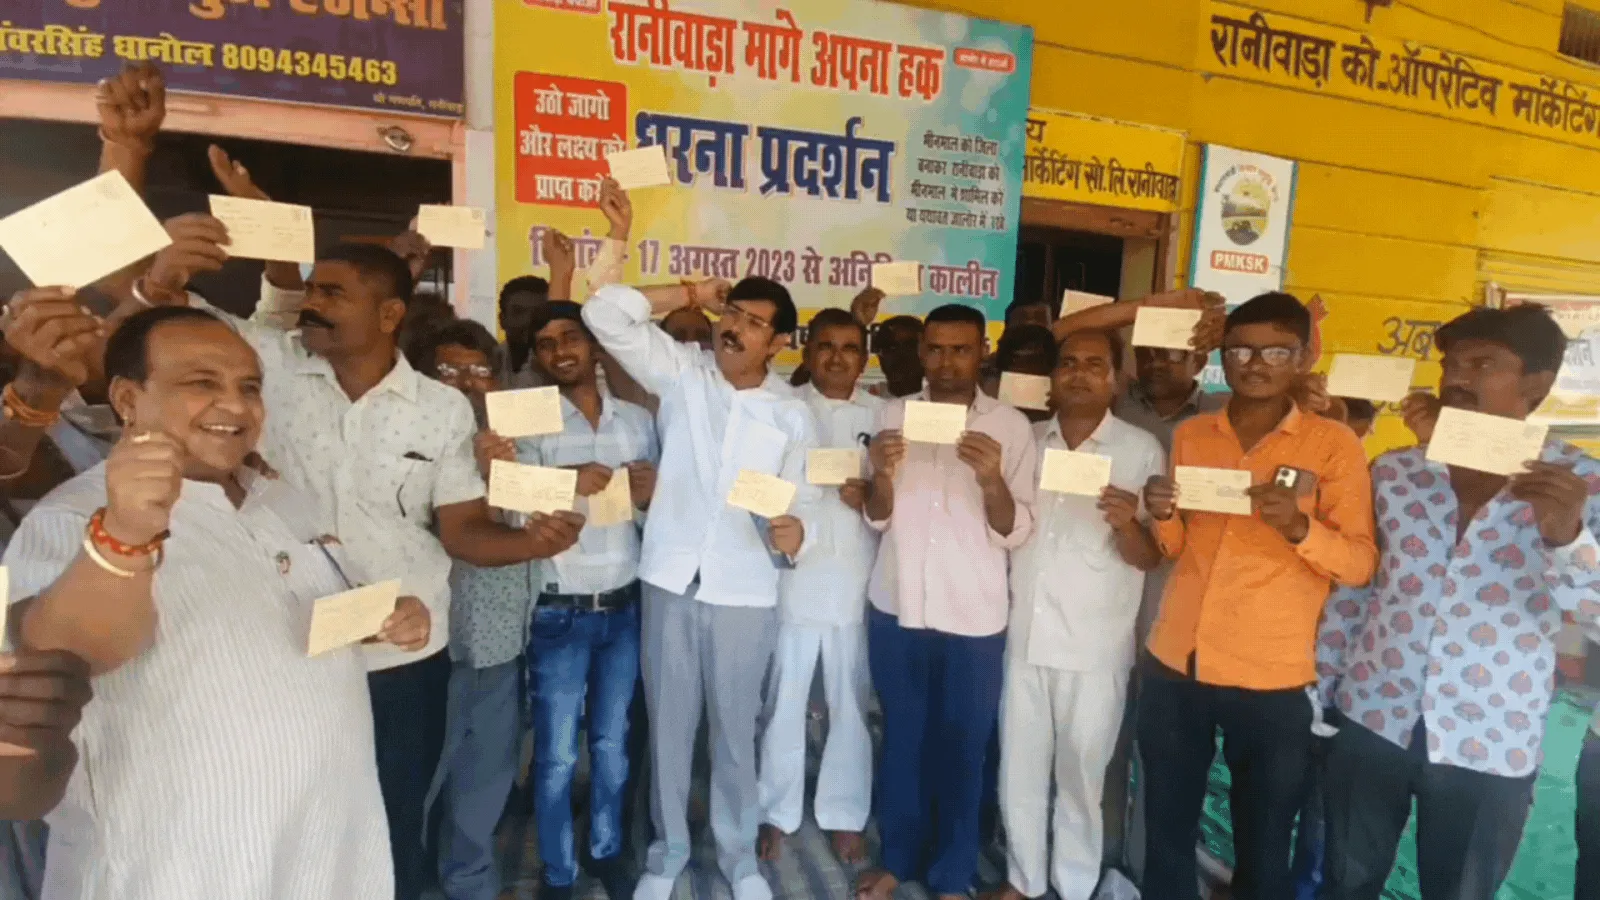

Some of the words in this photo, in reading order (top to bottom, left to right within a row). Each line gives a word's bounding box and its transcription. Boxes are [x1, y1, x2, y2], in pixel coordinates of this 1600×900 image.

[0, 20, 105, 57] ंवरसिंह
[222, 44, 397, 85] 8094345463
[811, 31, 892, 95] अपना
[897, 44, 945, 100] हक
[1211, 13, 1336, 88] रानीवाड़ा
[534, 84, 564, 116] उठो
[567, 89, 610, 120] जागो
[520, 124, 553, 156] और
[757, 116, 895, 202] प्रदर्शन
[535, 174, 574, 200] प्राप्त
[638, 240, 660, 274] 17
[669, 245, 740, 279] अगस्त
[745, 248, 795, 283] 2023
[802, 247, 823, 284] से
[928, 260, 999, 297] कालीन
[1215, 253, 1266, 271] PMKSK
